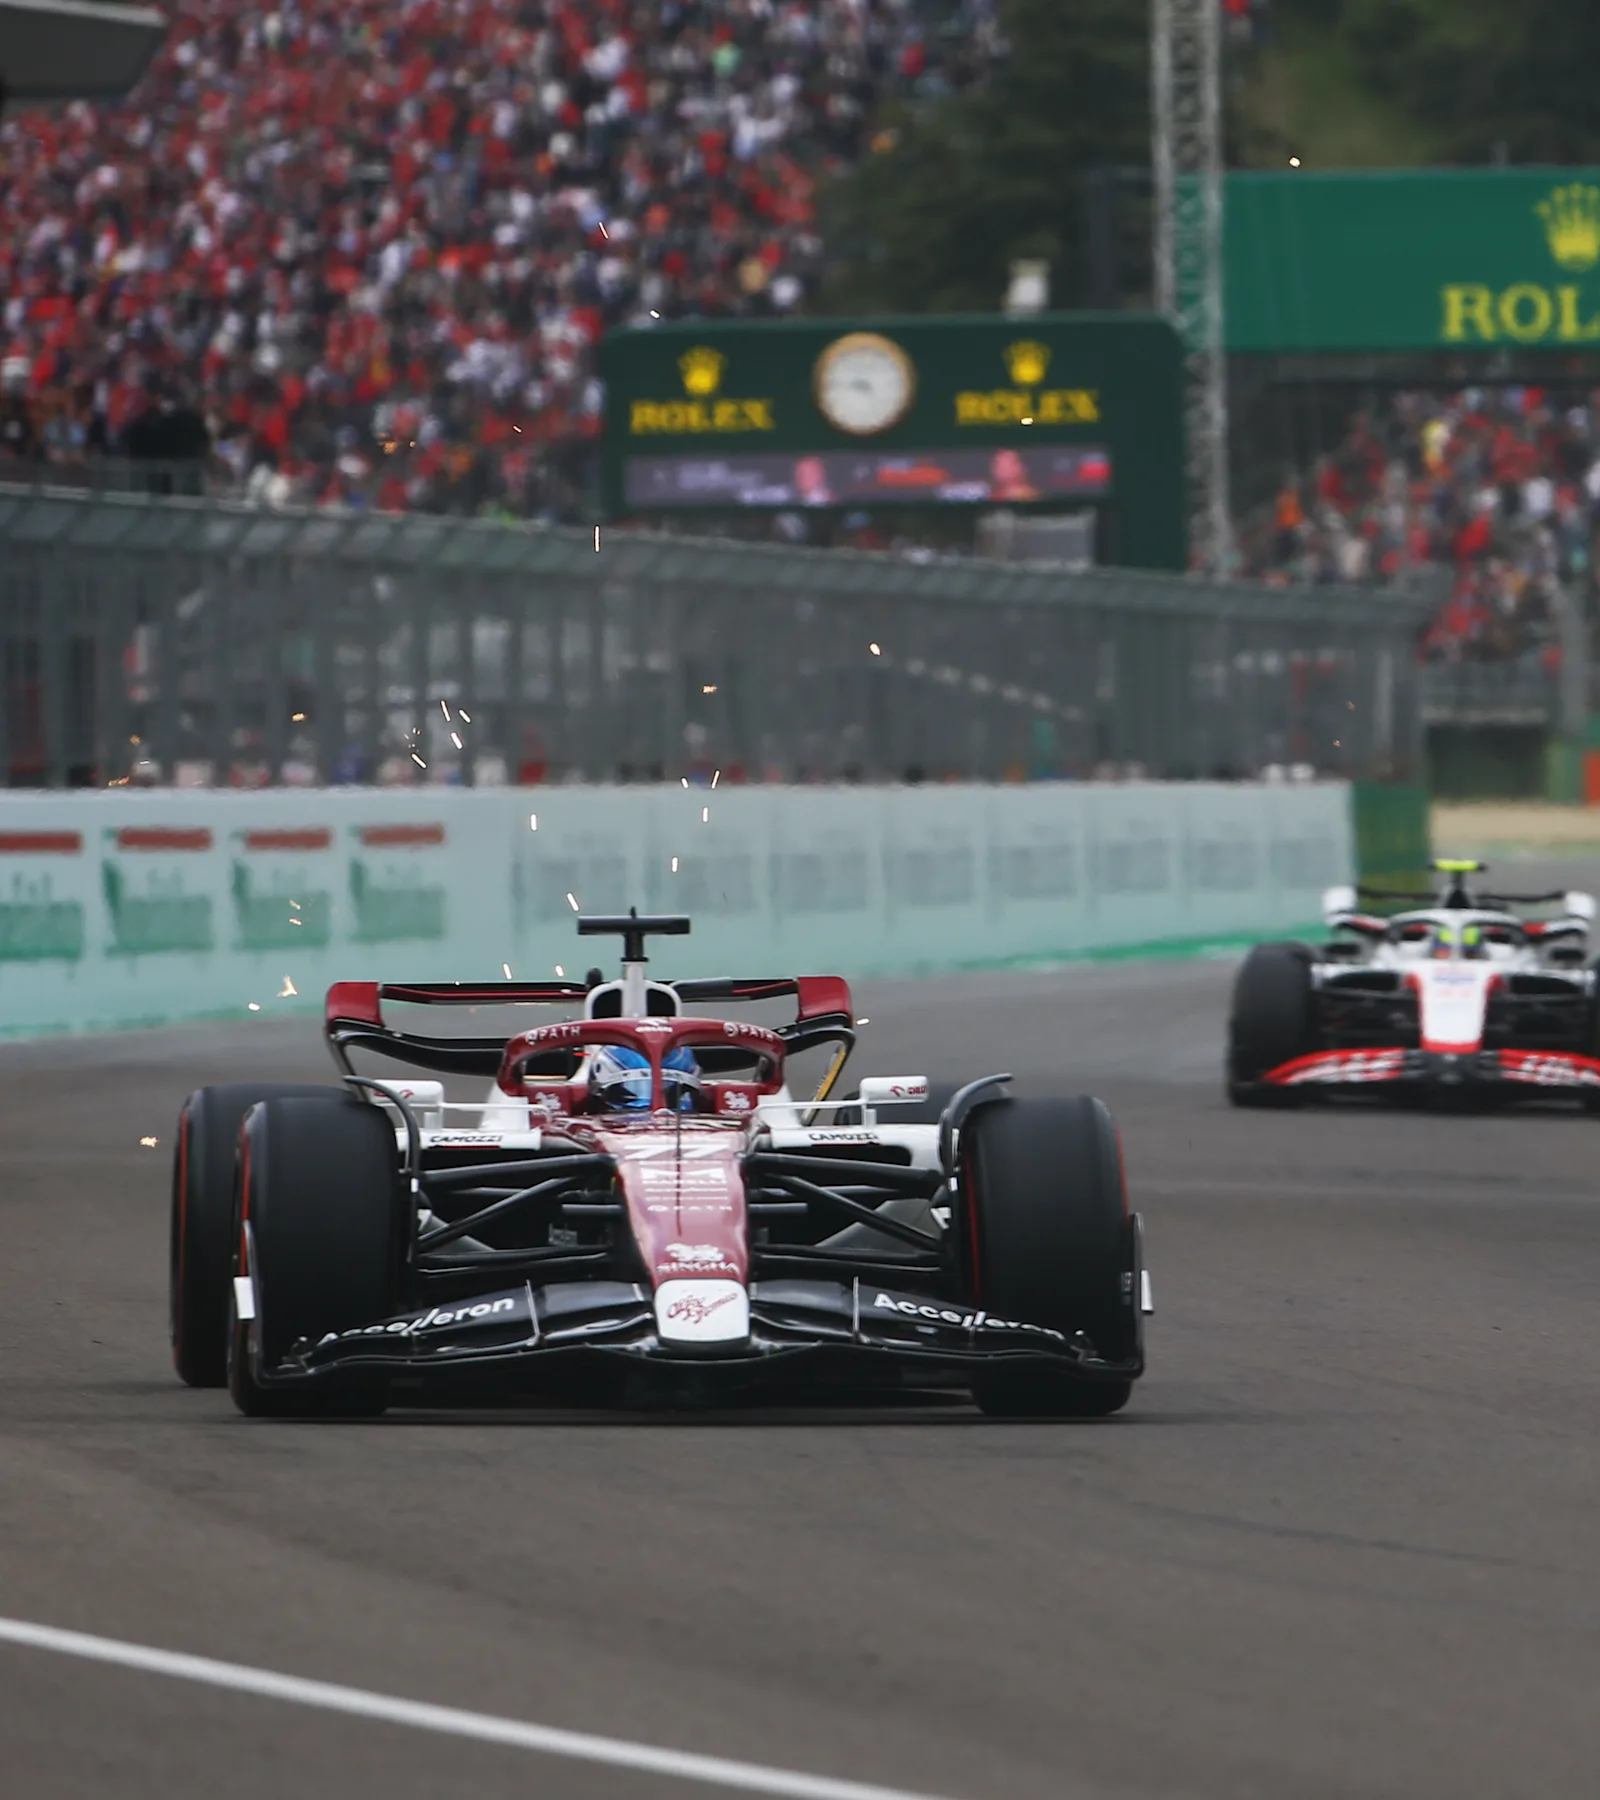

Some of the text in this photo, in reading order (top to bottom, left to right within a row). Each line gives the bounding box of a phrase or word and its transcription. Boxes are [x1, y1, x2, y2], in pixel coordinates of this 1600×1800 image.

[629, 400, 774, 435] ROLEX
[955, 390, 1099, 425] ROLEX
[430, 1134, 502, 1143] CAMOZZI
